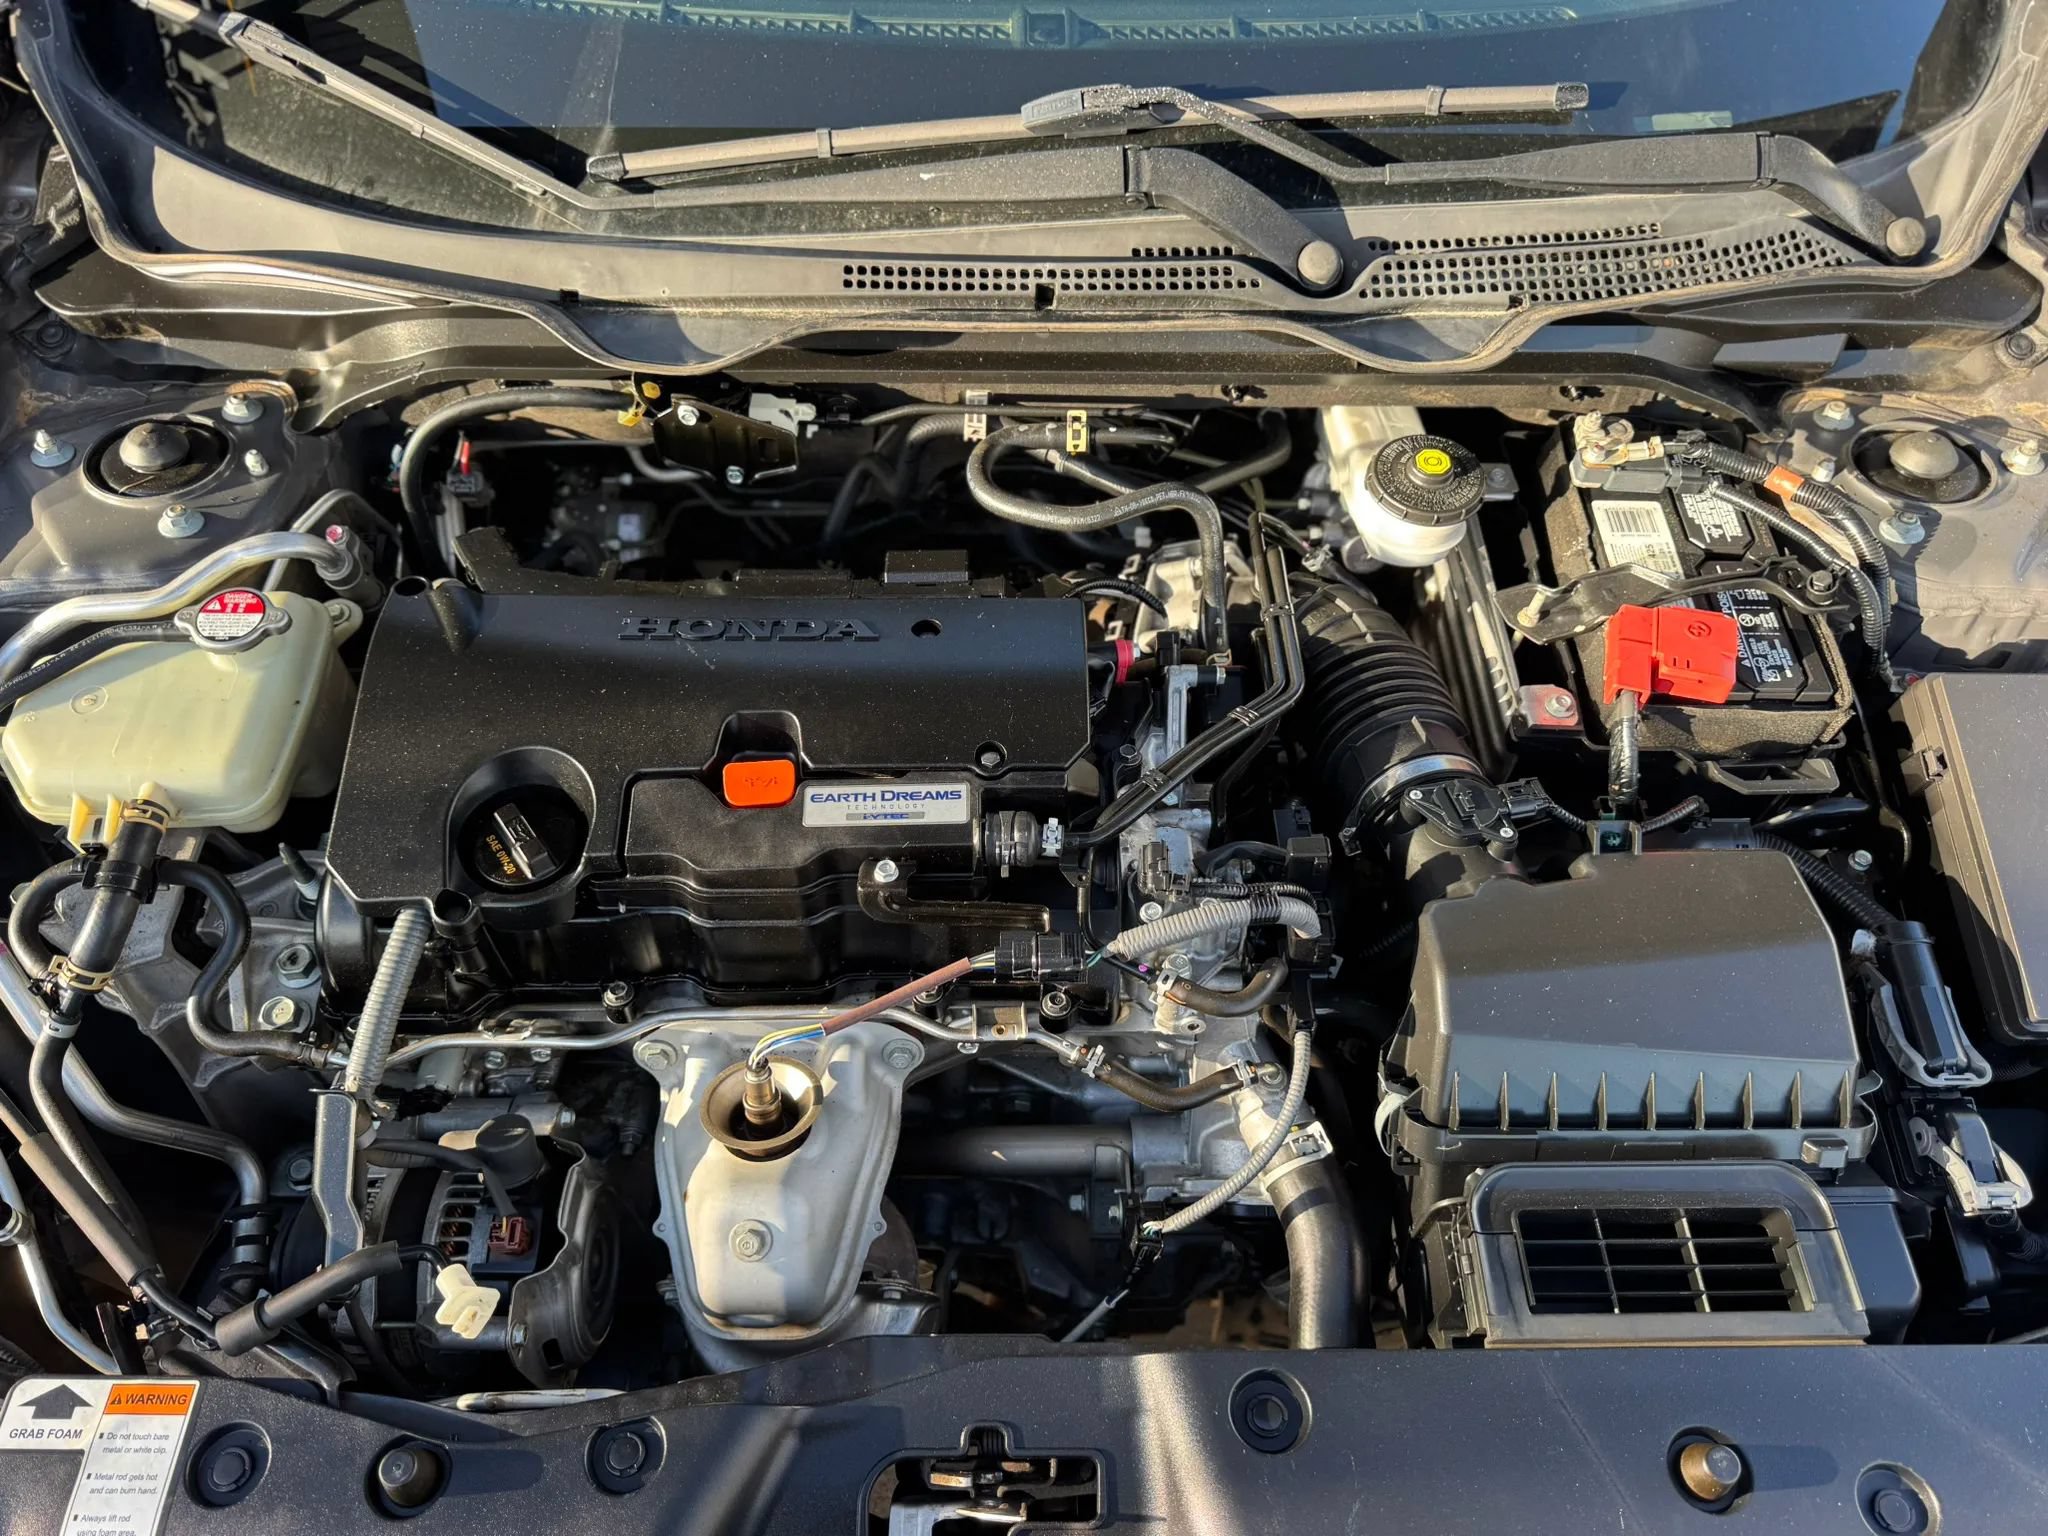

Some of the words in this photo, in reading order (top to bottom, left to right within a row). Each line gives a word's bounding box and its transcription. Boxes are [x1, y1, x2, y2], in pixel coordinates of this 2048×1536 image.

[1717, 591, 1732, 614] POIS
[618, 616, 880, 642] HONDA
[810, 792, 876, 804] EARTH
[880, 790, 962, 801] DREAMS
[847, 803, 925, 811] TECHNOLOGY
[486, 834, 503, 853] SAE
[496, 850, 517, 875] 0W-20
[125, 1393, 188, 1405] WARNING
[9, 1428, 45, 1440] GRAB
[47, 1428, 83, 1440] FOAM
[107, 1432, 118, 1440] Do
[119, 1432, 132, 1440] not
[132, 1432, 151, 1440] touch
[153, 1432, 170, 1440] bare
[102, 1446, 123, 1454] metal
[133, 1446, 152, 1454] white
[153, 1446, 168, 1455] clip.
[93, 1473, 114, 1481] Metal
[115, 1473, 128, 1481] rod
[128, 1473, 145, 1482] gets
[145, 1473, 158, 1481] hot
[89, 1487, 105, 1495] and
[137, 1487, 158, 1495] hand.
[80, 1514, 106, 1524] Always
[108, 1514, 118, 1522] lift
[119, 1514, 132, 1522] rod
[77, 1528, 97, 1536] using
[98, 1528, 117, 1536] foam
